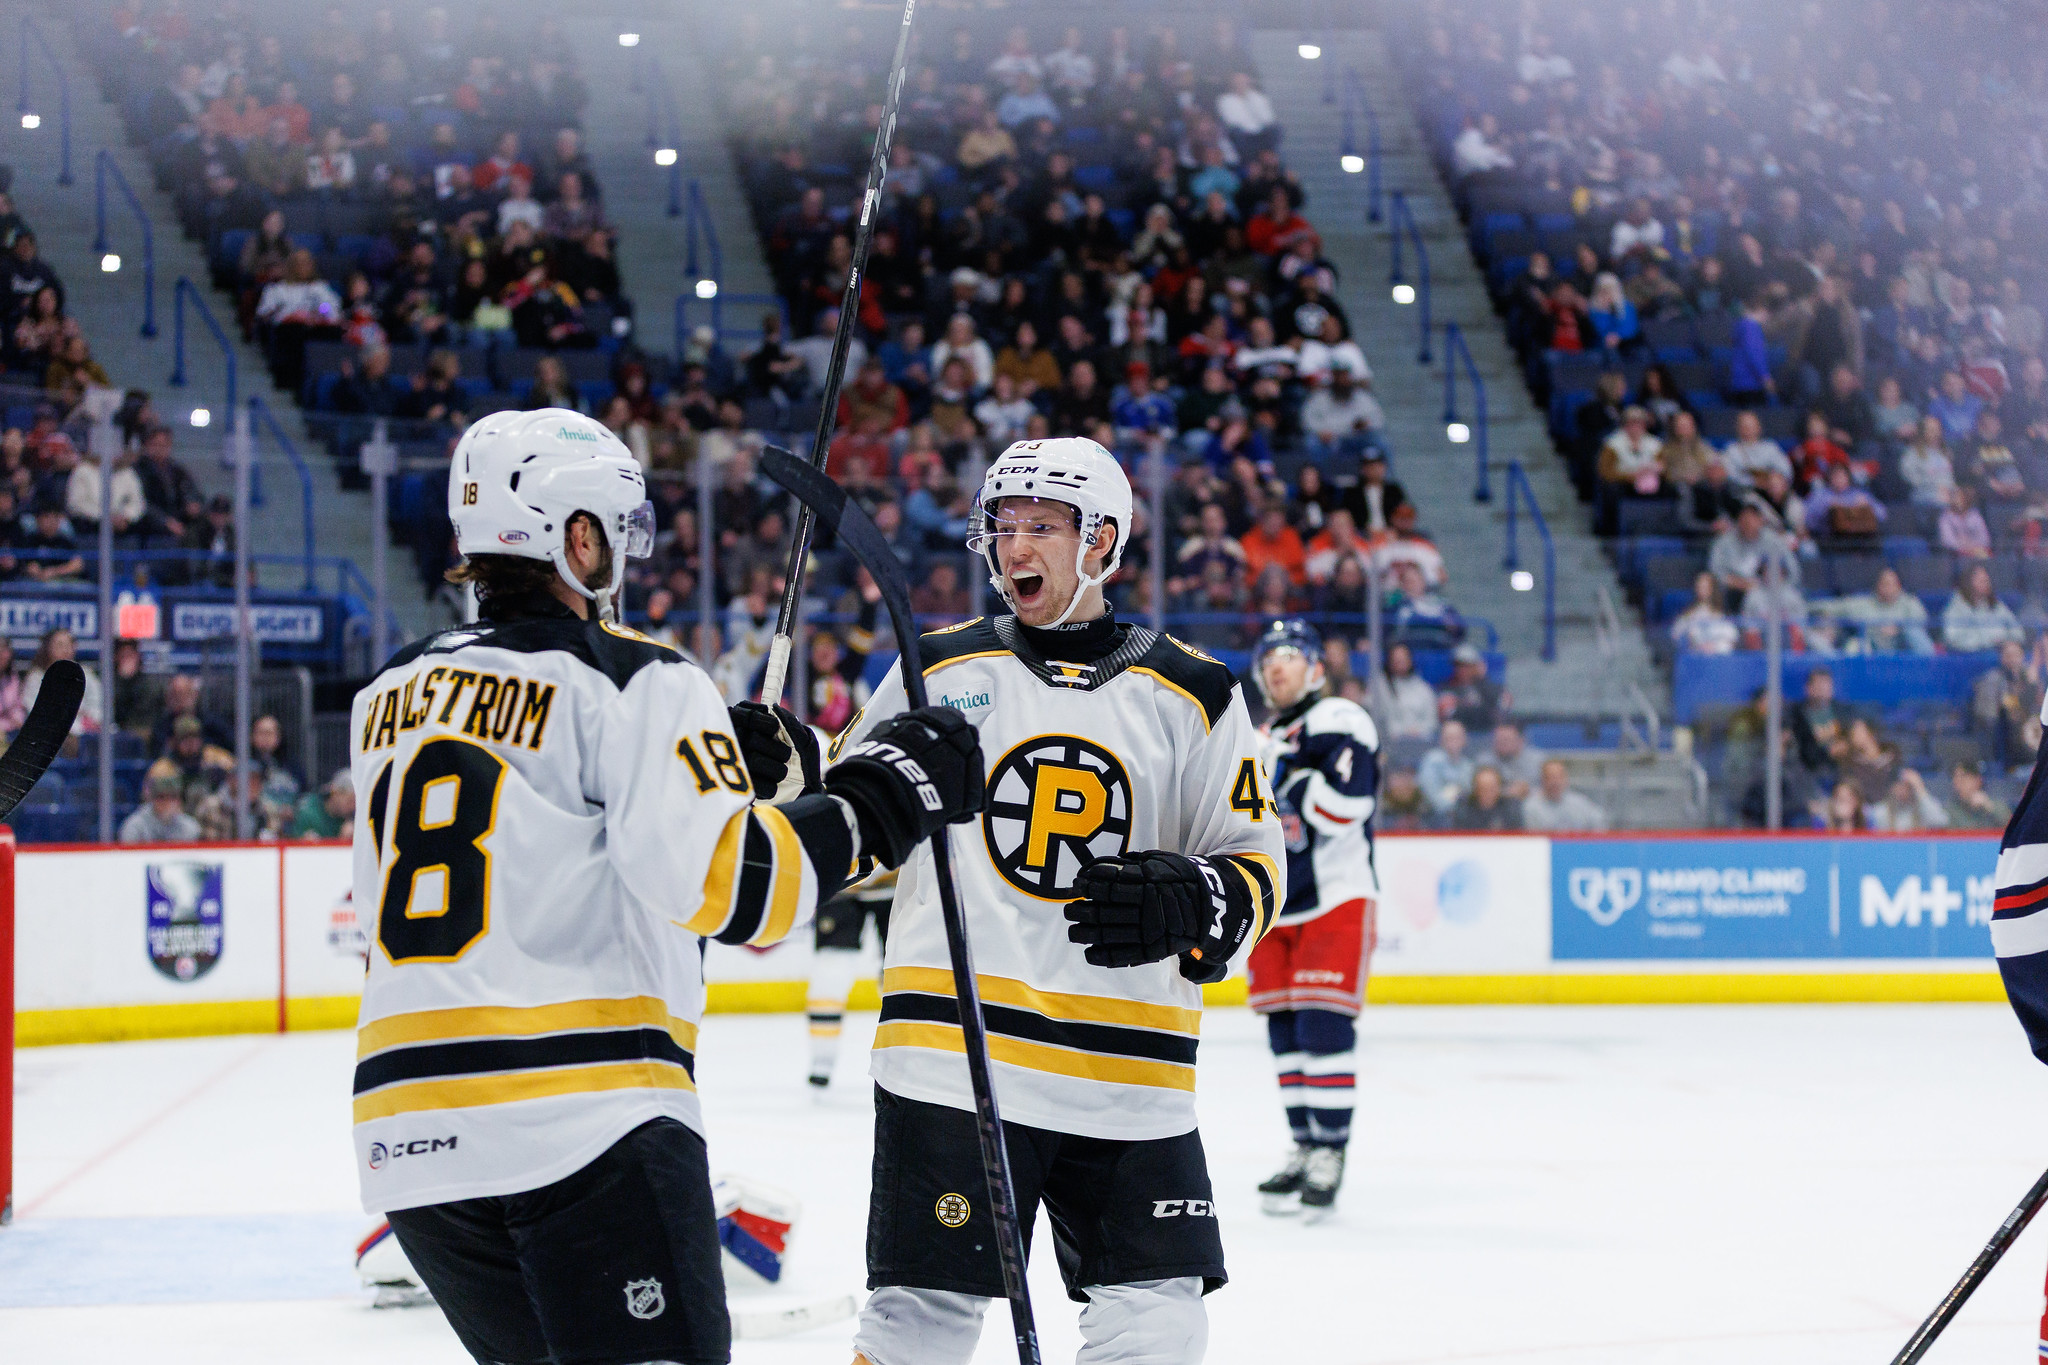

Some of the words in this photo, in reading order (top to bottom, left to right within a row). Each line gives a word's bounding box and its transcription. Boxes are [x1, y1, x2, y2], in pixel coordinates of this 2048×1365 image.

[997, 466, 1039, 475] CCM
[463, 483, 478, 505] 18
[1050, 622, 1090, 631] UER
[941, 691, 990, 710] Amica
[676, 730, 752, 797] 18
[1334, 747, 1354, 783] 4
[857, 741, 943, 811] BAUE
[1025, 764, 1108, 868] P
[1647, 868, 1722, 893] MAYO
[1724, 868, 1808, 894] CLINIC
[1703, 895, 1793, 917] Network
[1234, 918, 1248, 944] BRUINS
[393, 1135, 458, 1158] CCM
